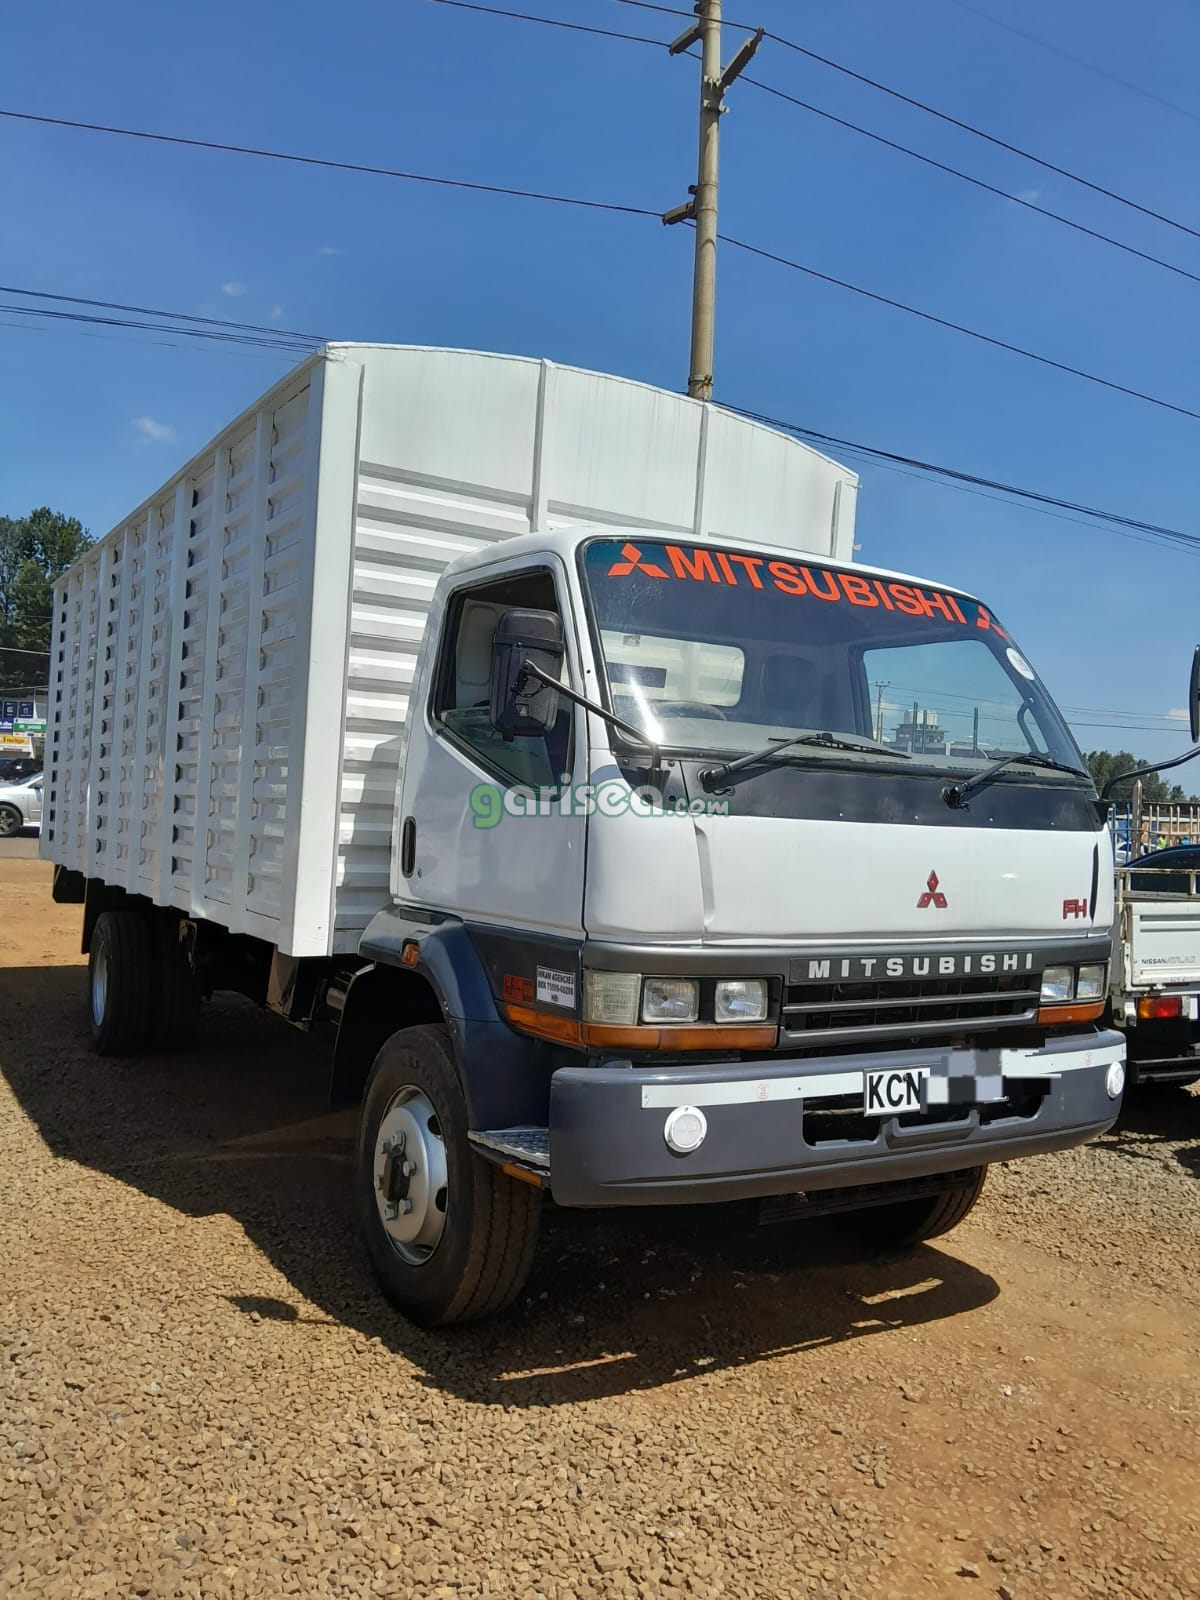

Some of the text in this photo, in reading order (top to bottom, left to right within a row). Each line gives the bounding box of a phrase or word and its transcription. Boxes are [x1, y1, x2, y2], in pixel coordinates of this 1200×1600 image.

[665, 545, 967, 625] MITSUBISHI
[808, 953, 1033, 979] MITSUBISHI
[868, 1071, 923, 1109] KCN
